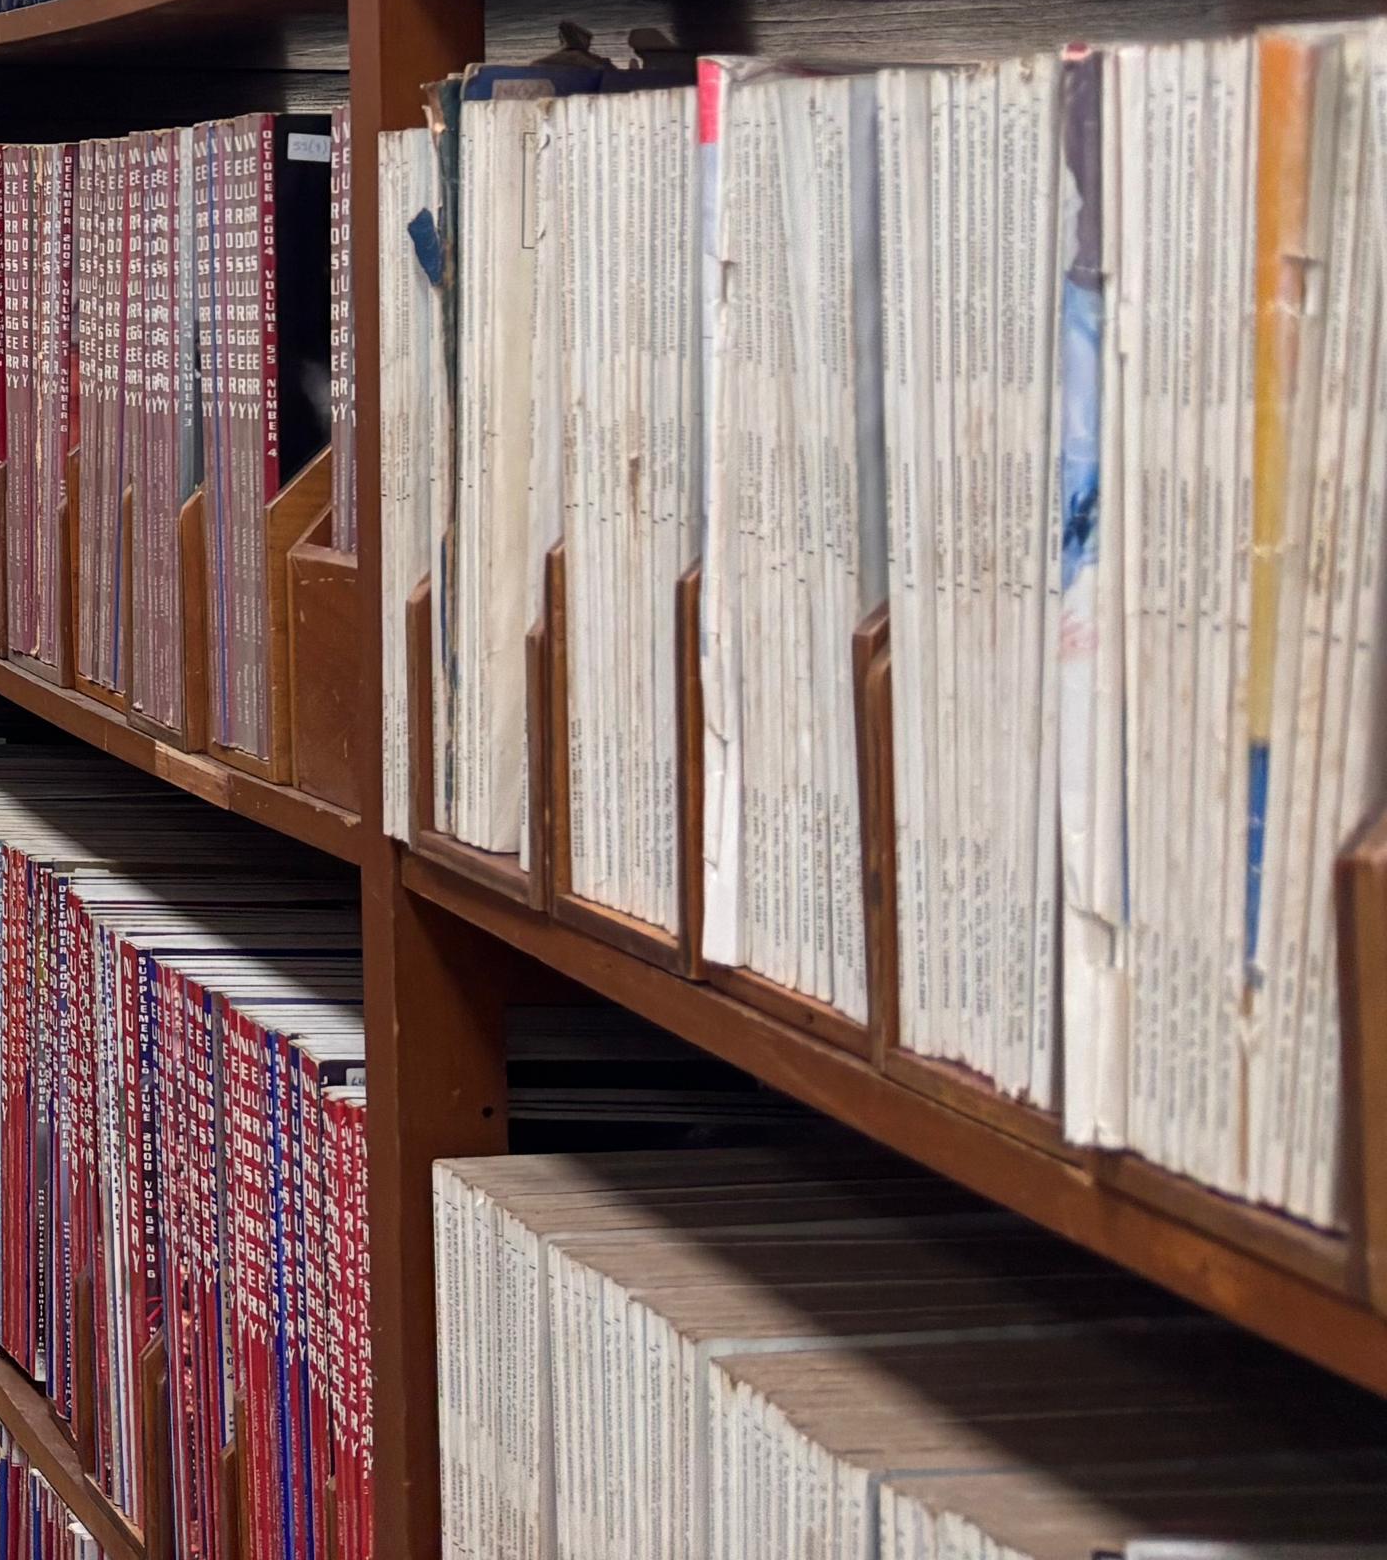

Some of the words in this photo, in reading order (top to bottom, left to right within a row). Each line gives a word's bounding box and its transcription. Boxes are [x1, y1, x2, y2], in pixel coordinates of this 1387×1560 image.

[63, 156, 72, 224] DECEMBER
[262, 130, 274, 202] OCTOBER
[4, 162, 13, 387] NEUROSURGERY
[11, 161, 19, 389] NEUROSURGERY
[63, 234, 71, 268] 2002
[112, 153, 125, 400] NEUROSURGERY
[224, 136, 236, 416] NEUROSURGERY
[249, 133, 260, 419] NEUROSURGERY
[264, 215, 273, 255] 2004
[331, 126, 340, 423] NEUROSURGERY
[340, 122, 350, 413] NEUROSURGERY
[62, 279, 70, 330] VOLUME
[105, 155, 116, 401] NEUROSURGERY
[234, 138, 246, 419] NEUROSURGERY
[265, 270, 276, 332] VOLUME
[61, 341, 68, 356] 51
[267, 346, 275, 363] 55
[267, 379, 277, 441] NUMBER
[267, 449, 277, 457] 4
[59, 886, 67, 955] DECEMBER
[59, 964, 67, 1001] 2007
[138, 956, 149, 1052] SUPPLEMENT
[61, 1067, 68, 1085] 61
[123, 955, 140, 1273] NEUROSURGERY
[142, 1086, 151, 1123] JUNE
[195, 1001, 212, 1294] NEUROSURGERY
[240, 1036, 259, 1341] NEUROSURGERY
[144, 1183, 153, 1208] VOL
[146, 1216, 153, 1234] 62
[249, 1039, 268, 1345] NEUROSURGERY
[263, 1046, 281, 1337] NEUROSURGERY
[290, 1066, 307, 1362] NEUROSURGERY
[302, 1073, 319, 1391] NEUROSURGERY
[146, 1244, 155, 1262] NO
[146, 1269, 155, 1279] 6
[309, 1080, 326, 1401] NEUROSURGERY
